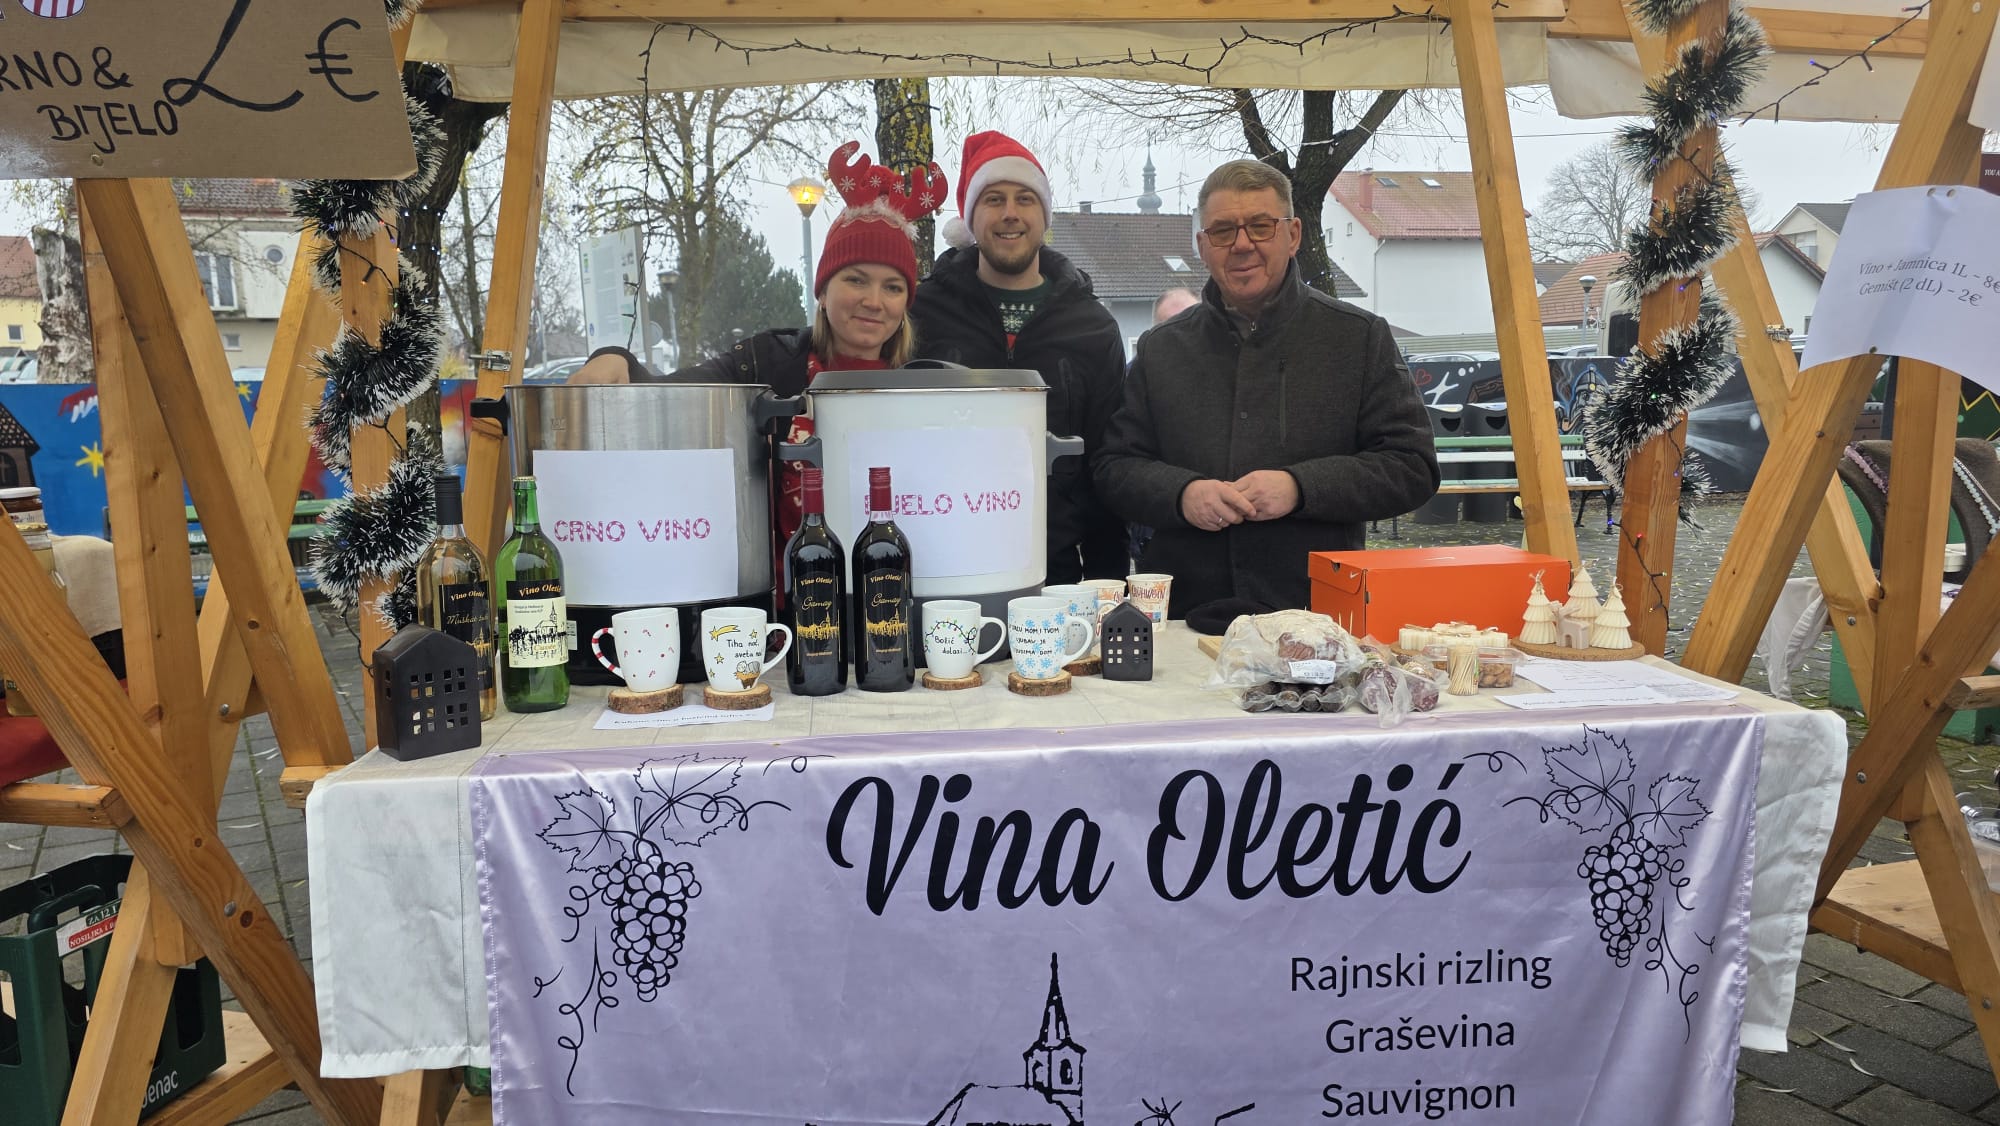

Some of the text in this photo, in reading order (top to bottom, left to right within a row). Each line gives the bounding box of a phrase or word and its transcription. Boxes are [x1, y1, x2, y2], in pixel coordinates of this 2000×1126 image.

[91, 46, 134, 90] &
[304, 17, 380, 102] €
[37, 99, 178, 154] BIJELO
[1860, 263, 1884, 275] Vino
[1894, 257, 1947, 272] Jamnica
[1859, 279, 1899, 295] Gemišt
[1899, 277, 1914, 293] (2
[1915, 278, 1943, 296] dL)
[1957, 289, 1982, 306] 2€
[963, 490, 1021, 514] VINO
[553, 517, 711, 543] CRNO VINO
[519, 587, 540, 598] Vino
[802, 596, 832, 611] Gamay
[872, 593, 902, 607] Gamay
[727, 639, 743, 648] Tiha
[826, 759, 1472, 917] Vina Oletić
[1291, 948, 1552, 998] Rajnski rizling
[1325, 1013, 1515, 1054] Graševina
[1321, 1078, 1515, 1121] Sauvignon
